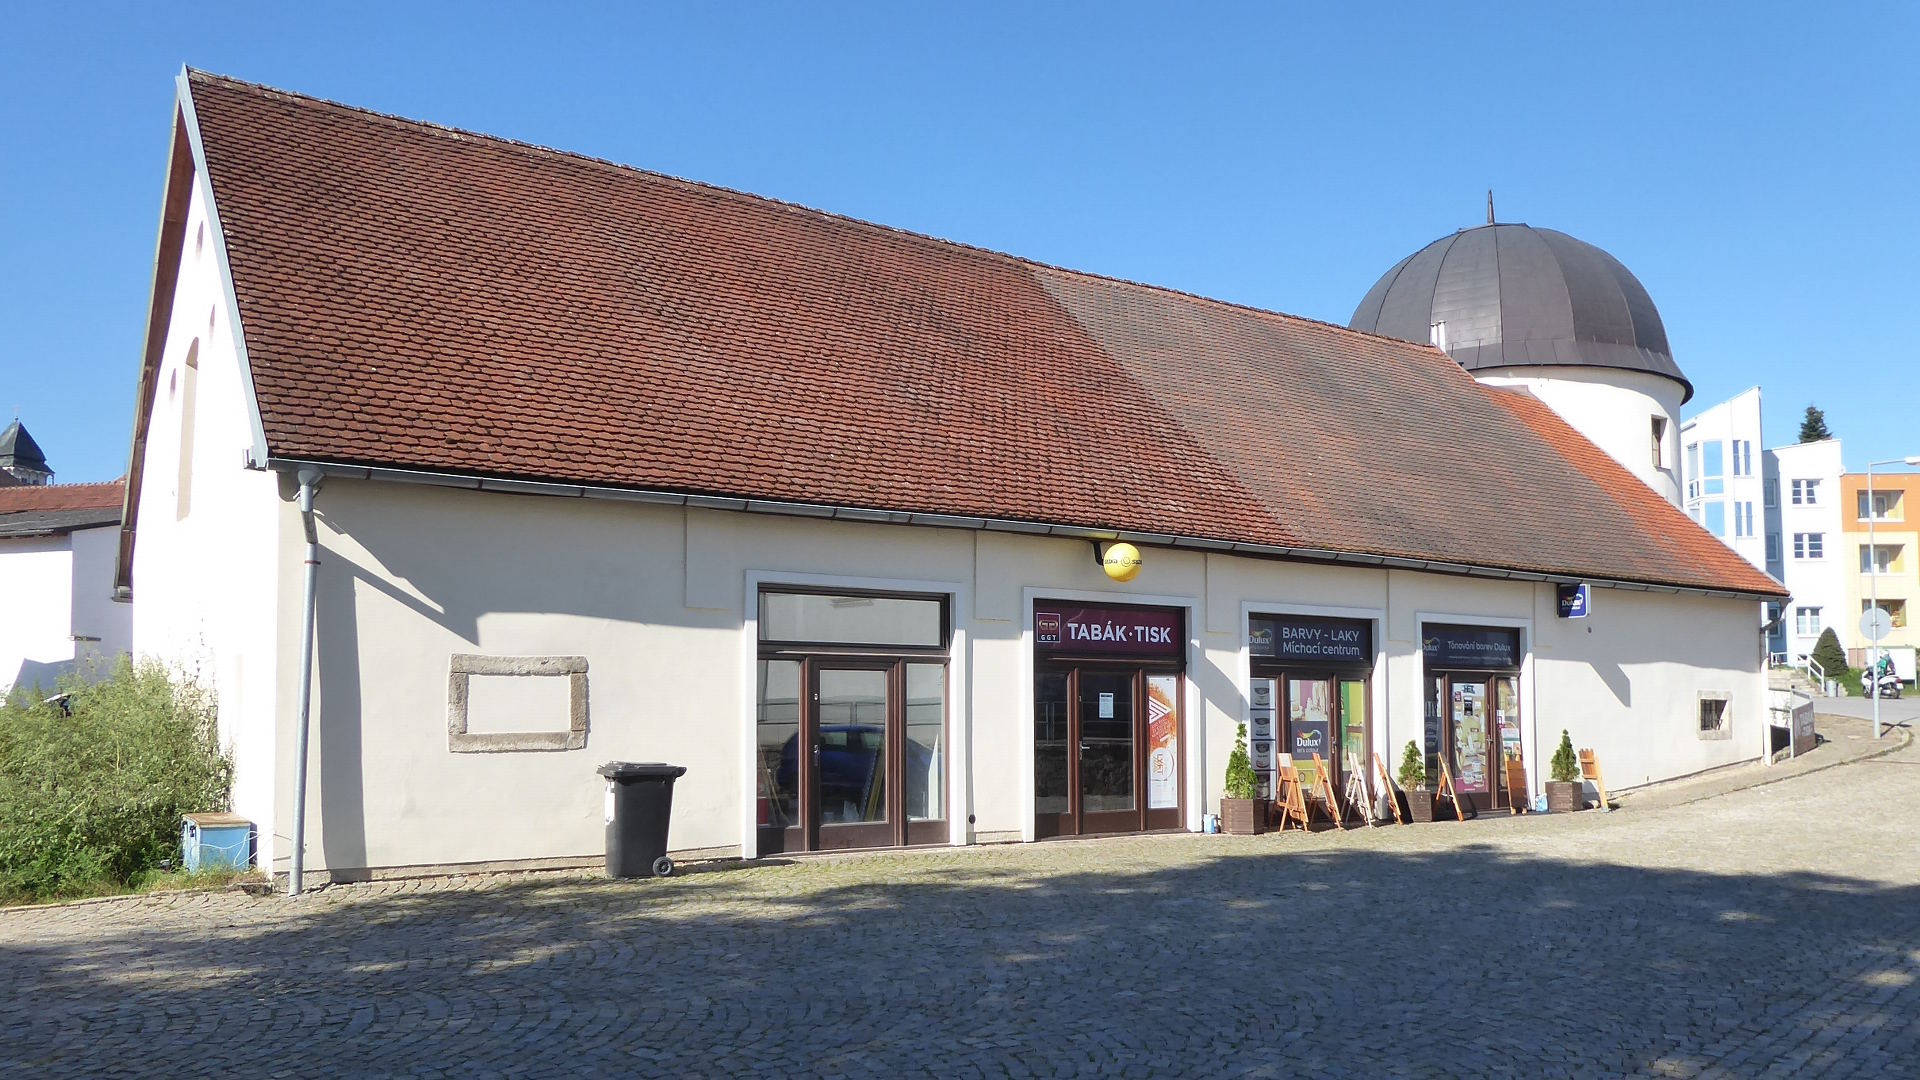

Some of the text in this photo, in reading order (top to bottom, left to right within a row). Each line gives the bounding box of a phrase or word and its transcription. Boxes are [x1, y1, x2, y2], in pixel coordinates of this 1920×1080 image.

[1067, 620, 1128, 641] TABÁK
[1134, 625, 1171, 643] TISK
[1282, 627, 1321, 640] BARVY
[1331, 629, 1360, 642] LAKY
[1283, 640, 1360, 656] Míchací centrum
[1296, 737, 1319, 747] Dulux
